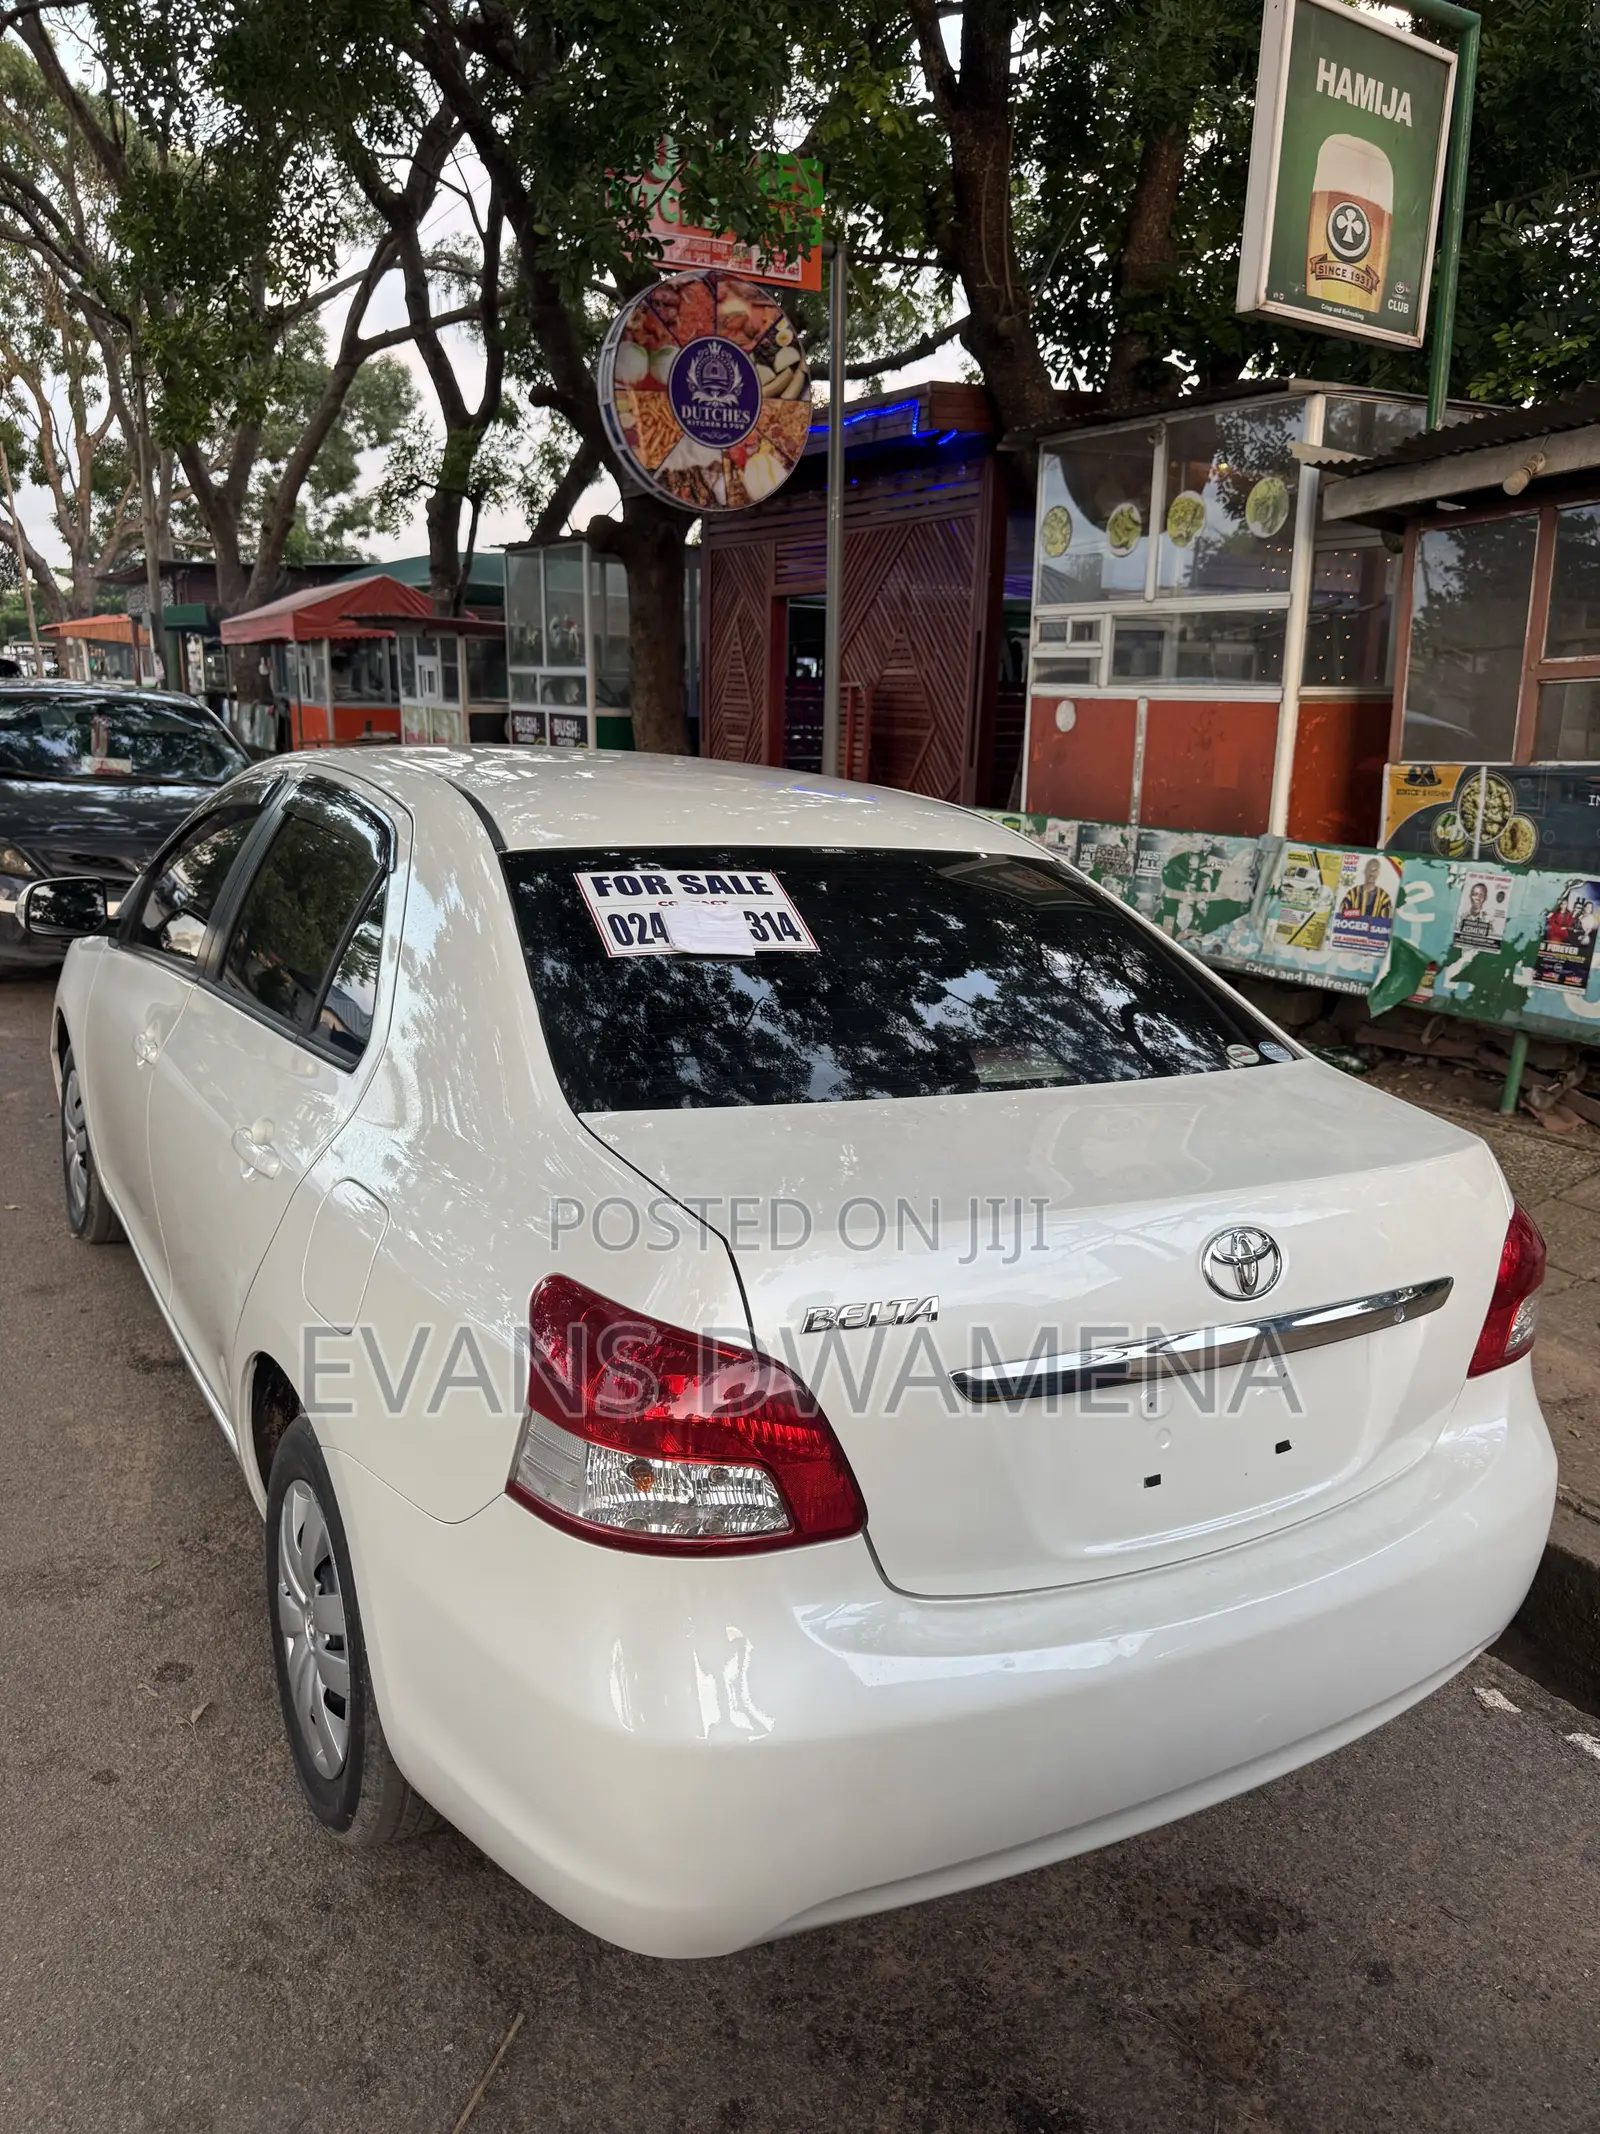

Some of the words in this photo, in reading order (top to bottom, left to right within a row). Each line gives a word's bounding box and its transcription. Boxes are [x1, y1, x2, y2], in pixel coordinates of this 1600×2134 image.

[1316, 57, 1412, 127] HAMIJA
[1318, 265, 1347, 278] SINCE
[1350, 272, 1371, 287] 1931
[1321, 303, 1333, 313] Crisp
[1388, 299, 1409, 314] CLUB
[681, 405, 751, 424] DUTCHES
[687, 420, 720, 428] KITCHEN
[729, 422, 745, 430] PUB
[553, 718, 578, 738] BUSH
[591, 875, 674, 897] FOR
[676, 874, 774, 896] SALE
[606, 913, 670, 947] 024
[743, 911, 803, 942] 314
[1333, 919, 1369, 931] ROGER
[1278, 970, 1302, 982] and
[1306, 973, 1370, 996] Refreshin
[799, 1294, 942, 1335] BELTA
